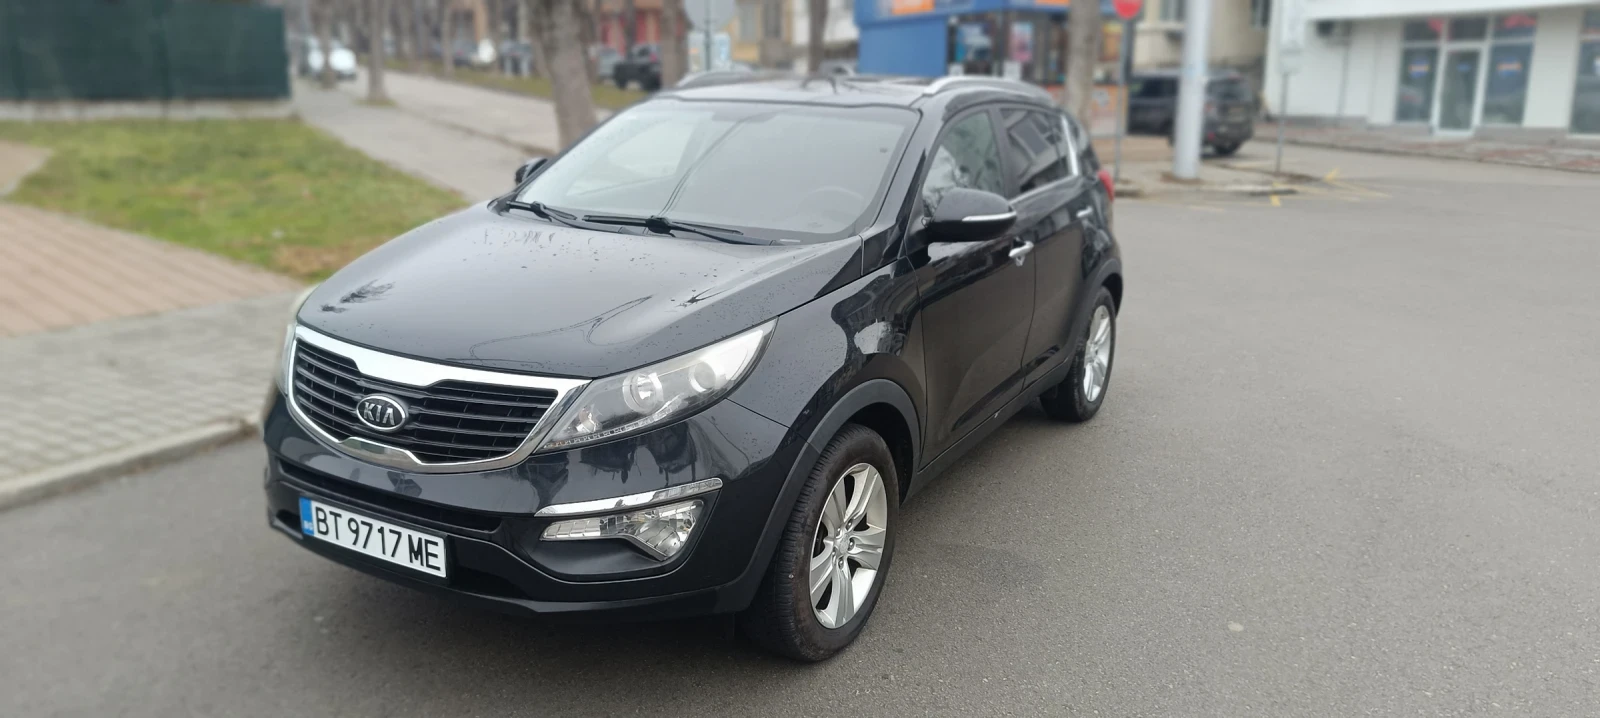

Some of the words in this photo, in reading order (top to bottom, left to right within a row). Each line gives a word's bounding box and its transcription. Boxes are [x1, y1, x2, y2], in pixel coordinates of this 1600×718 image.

[364, 402, 395, 425] KIA
[315, 506, 341, 540] BT
[347, 517, 402, 558] 9717
[408, 534, 441, 571] ME
